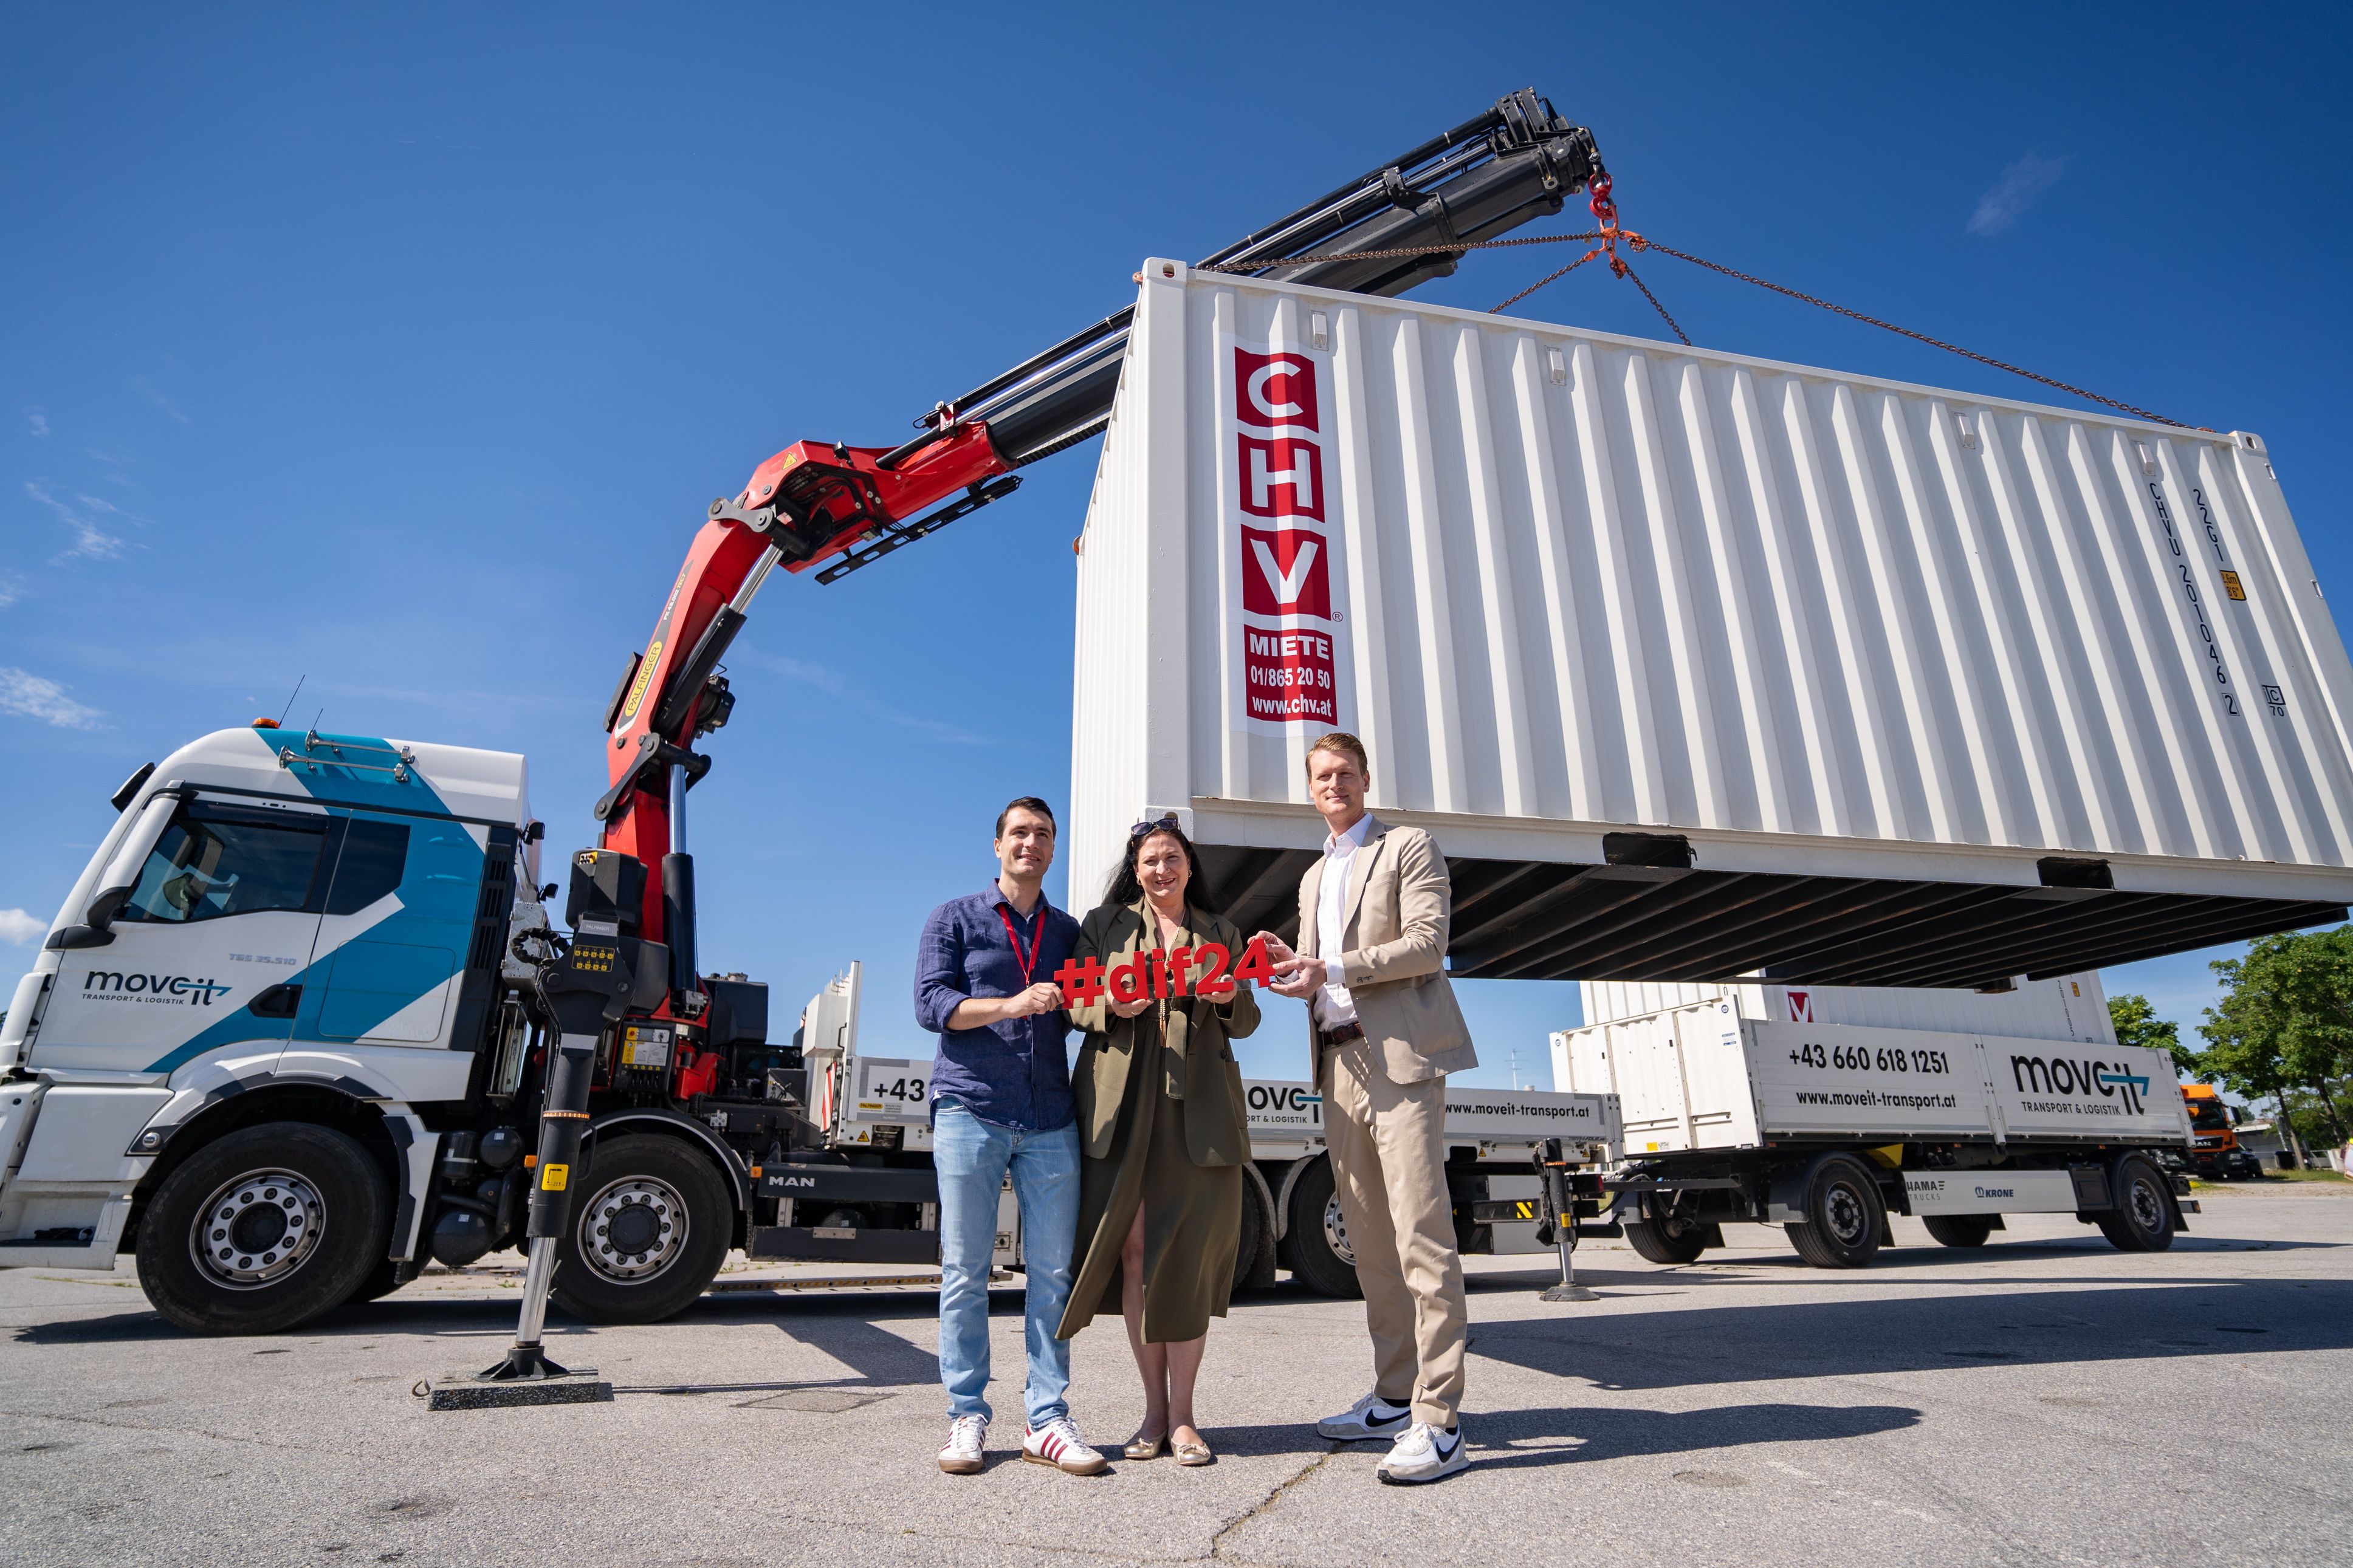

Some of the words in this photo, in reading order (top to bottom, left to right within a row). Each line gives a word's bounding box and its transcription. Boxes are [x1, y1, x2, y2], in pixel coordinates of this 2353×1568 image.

[2193, 488, 2224, 561] 22G1
[2149, 483, 2180, 556] CHVU
[2179, 564, 2227, 684] 201046
[1249, 632, 1329, 660] MIETE
[628, 647, 659, 711] PALFINGER
[1251, 665, 1294, 687] 01/865
[1297, 666, 1314, 686] 20
[1317, 669, 1330, 690] 50
[1252, 693, 1331, 717] www.chv.at
[1054, 938, 1276, 1009] #dif24
[82, 993, 134, 1002] TRANSPORT
[1789, 1044, 1827, 1069] +43
[1833, 1046, 1870, 1071] 660
[1877, 1048, 1908, 1072] 618
[1911, 1050, 1949, 1074] 1251
[874, 1078, 925, 1102] +43
[1796, 1089, 1956, 1111] www.moveit-transport.at
[2021, 1101, 2072, 1114] TRANSPORT
[2075, 1104, 2081, 1114] &
[2084, 1104, 2121, 1115] LOGISTIK
[769, 1176, 815, 1187] MAN
[1985, 1189, 2014, 1198] KRONE
